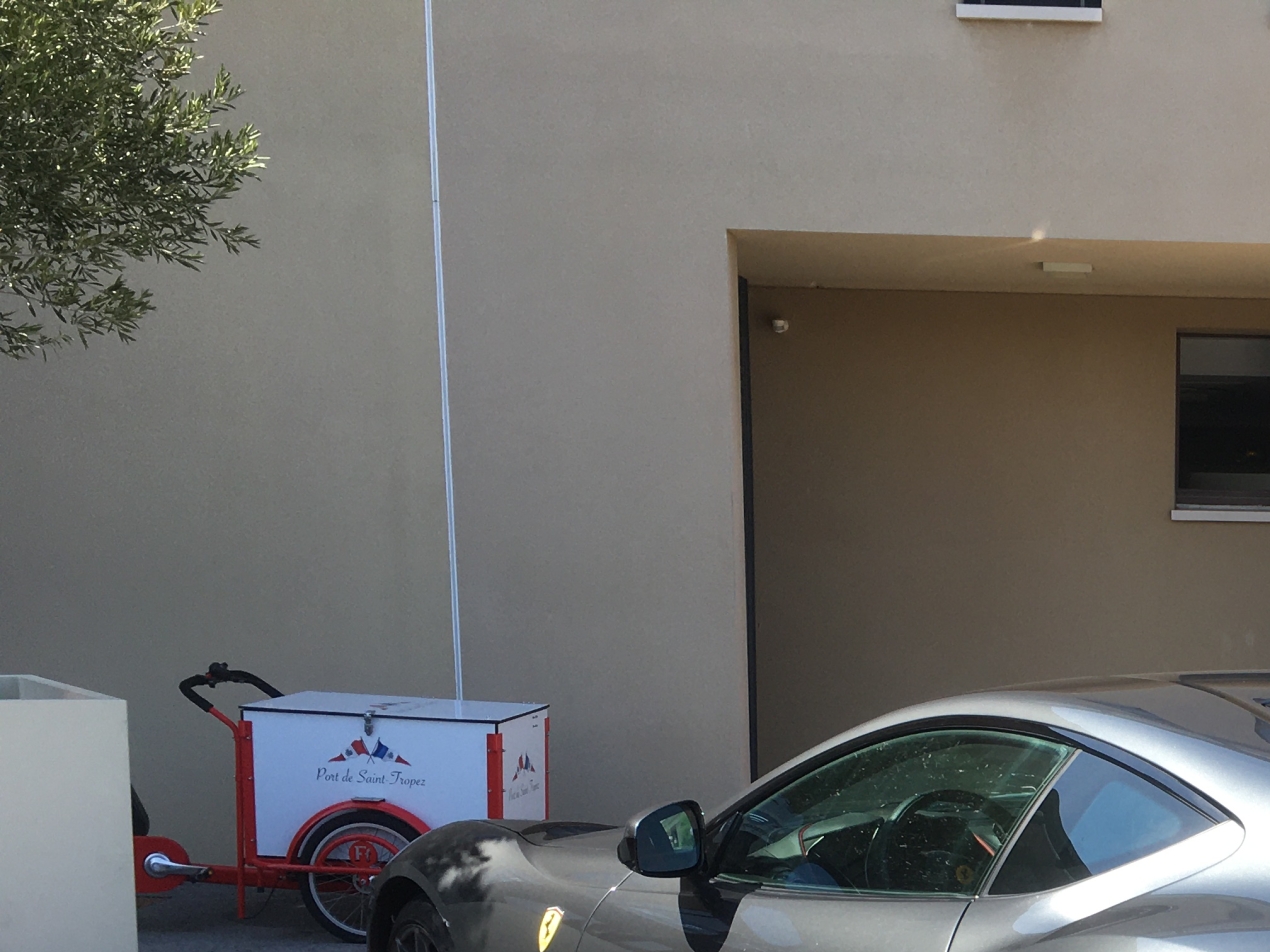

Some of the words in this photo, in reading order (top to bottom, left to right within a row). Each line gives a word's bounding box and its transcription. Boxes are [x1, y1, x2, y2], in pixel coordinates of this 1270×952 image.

[316, 767, 340, 781] Port
[342, 768, 354, 783] de
[356, 769, 426, 789] Saint-Tropez
